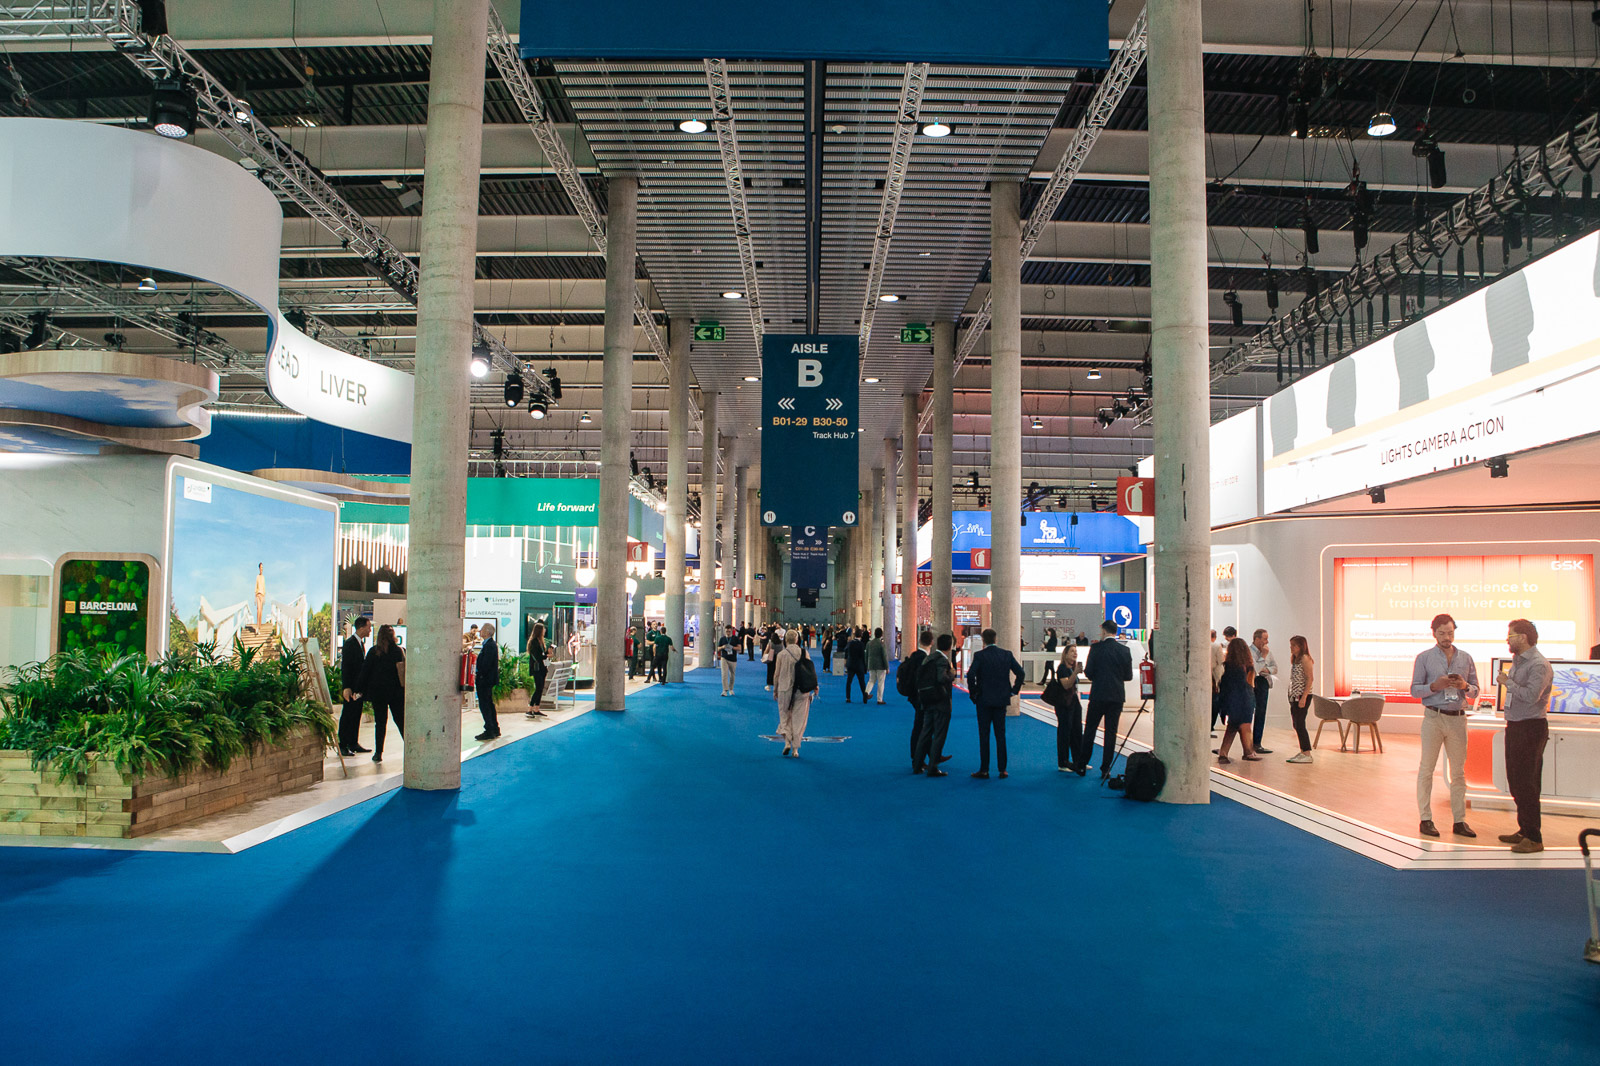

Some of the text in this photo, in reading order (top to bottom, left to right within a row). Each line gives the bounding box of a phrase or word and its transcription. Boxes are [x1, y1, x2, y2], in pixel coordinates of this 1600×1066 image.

[791, 344, 828, 354] AISLE
[275, 345, 300, 378] LEAD
[798, 359, 824, 388] B
[320, 370, 366, 406] LIVER
[772, 417, 848, 426] B01-29 B30-50
[1381, 416, 1504, 465] LIGHTS CAMERA ACTION
[537, 502, 595, 512] Life forward
[804, 526, 816, 536] C
[1550, 560, 1584, 570] GSK
[1382, 581, 1538, 596] Advancing science to
[80, 601, 138, 611] BARCELONA
[1389, 597, 1532, 608] transform liver care
